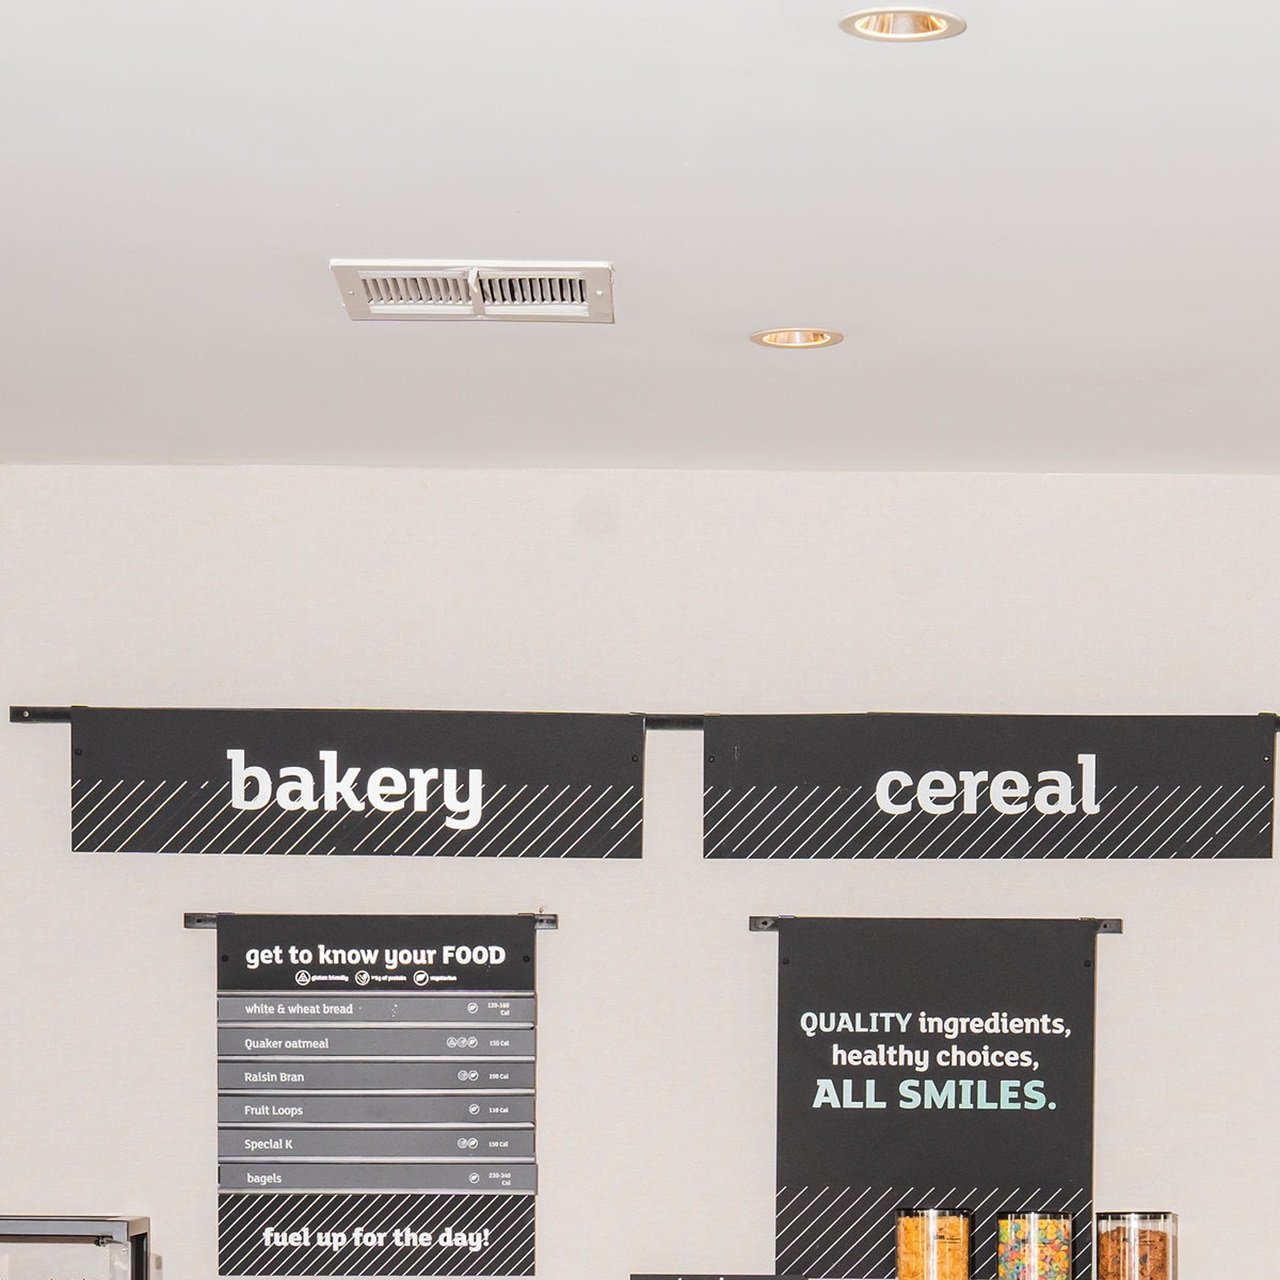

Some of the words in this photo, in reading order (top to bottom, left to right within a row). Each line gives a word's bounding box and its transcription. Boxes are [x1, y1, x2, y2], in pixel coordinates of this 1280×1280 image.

[226, 749, 485, 831] bakery
[875, 754, 1101, 816] cereal
[245, 945, 284, 970] get
[288, 945, 313, 965] to
[317, 944, 380, 965] know
[384, 948, 437, 970] your
[442, 945, 506, 965] FOOD
[245, 1003, 275, 1015] white
[276, 1003, 286, 1015] &
[287, 1003, 320, 1015] wheat
[322, 1003, 354, 1015] bread
[800, 1011, 913, 1038] QUALITY
[918, 1011, 1072, 1040] ingredients,
[244, 1037, 283, 1051] Quaker
[284, 1037, 329, 1049] oatmeal
[832, 1044, 930, 1071] healthy
[936, 1044, 1039, 1071] choices,
[244, 1071, 277, 1082] Raisin
[279, 1072, 305, 1082] Bran
[812, 1078, 887, 1109] ALL
[898, 1079, 1057, 1110] SMILES.
[244, 1104, 270, 1116] Fruit
[272, 1105, 304, 1118] Loops
[244, 1138, 283, 1152] Special
[285, 1139, 293, 1150] K
[246, 1172, 283, 1186] bagels
[263, 1227, 311, 1247] fuel
[317, 1231, 347, 1251] up
[352, 1227, 387, 1247] for
[392, 1228, 433, 1247] the
[438, 1228, 490, 1252] day!
